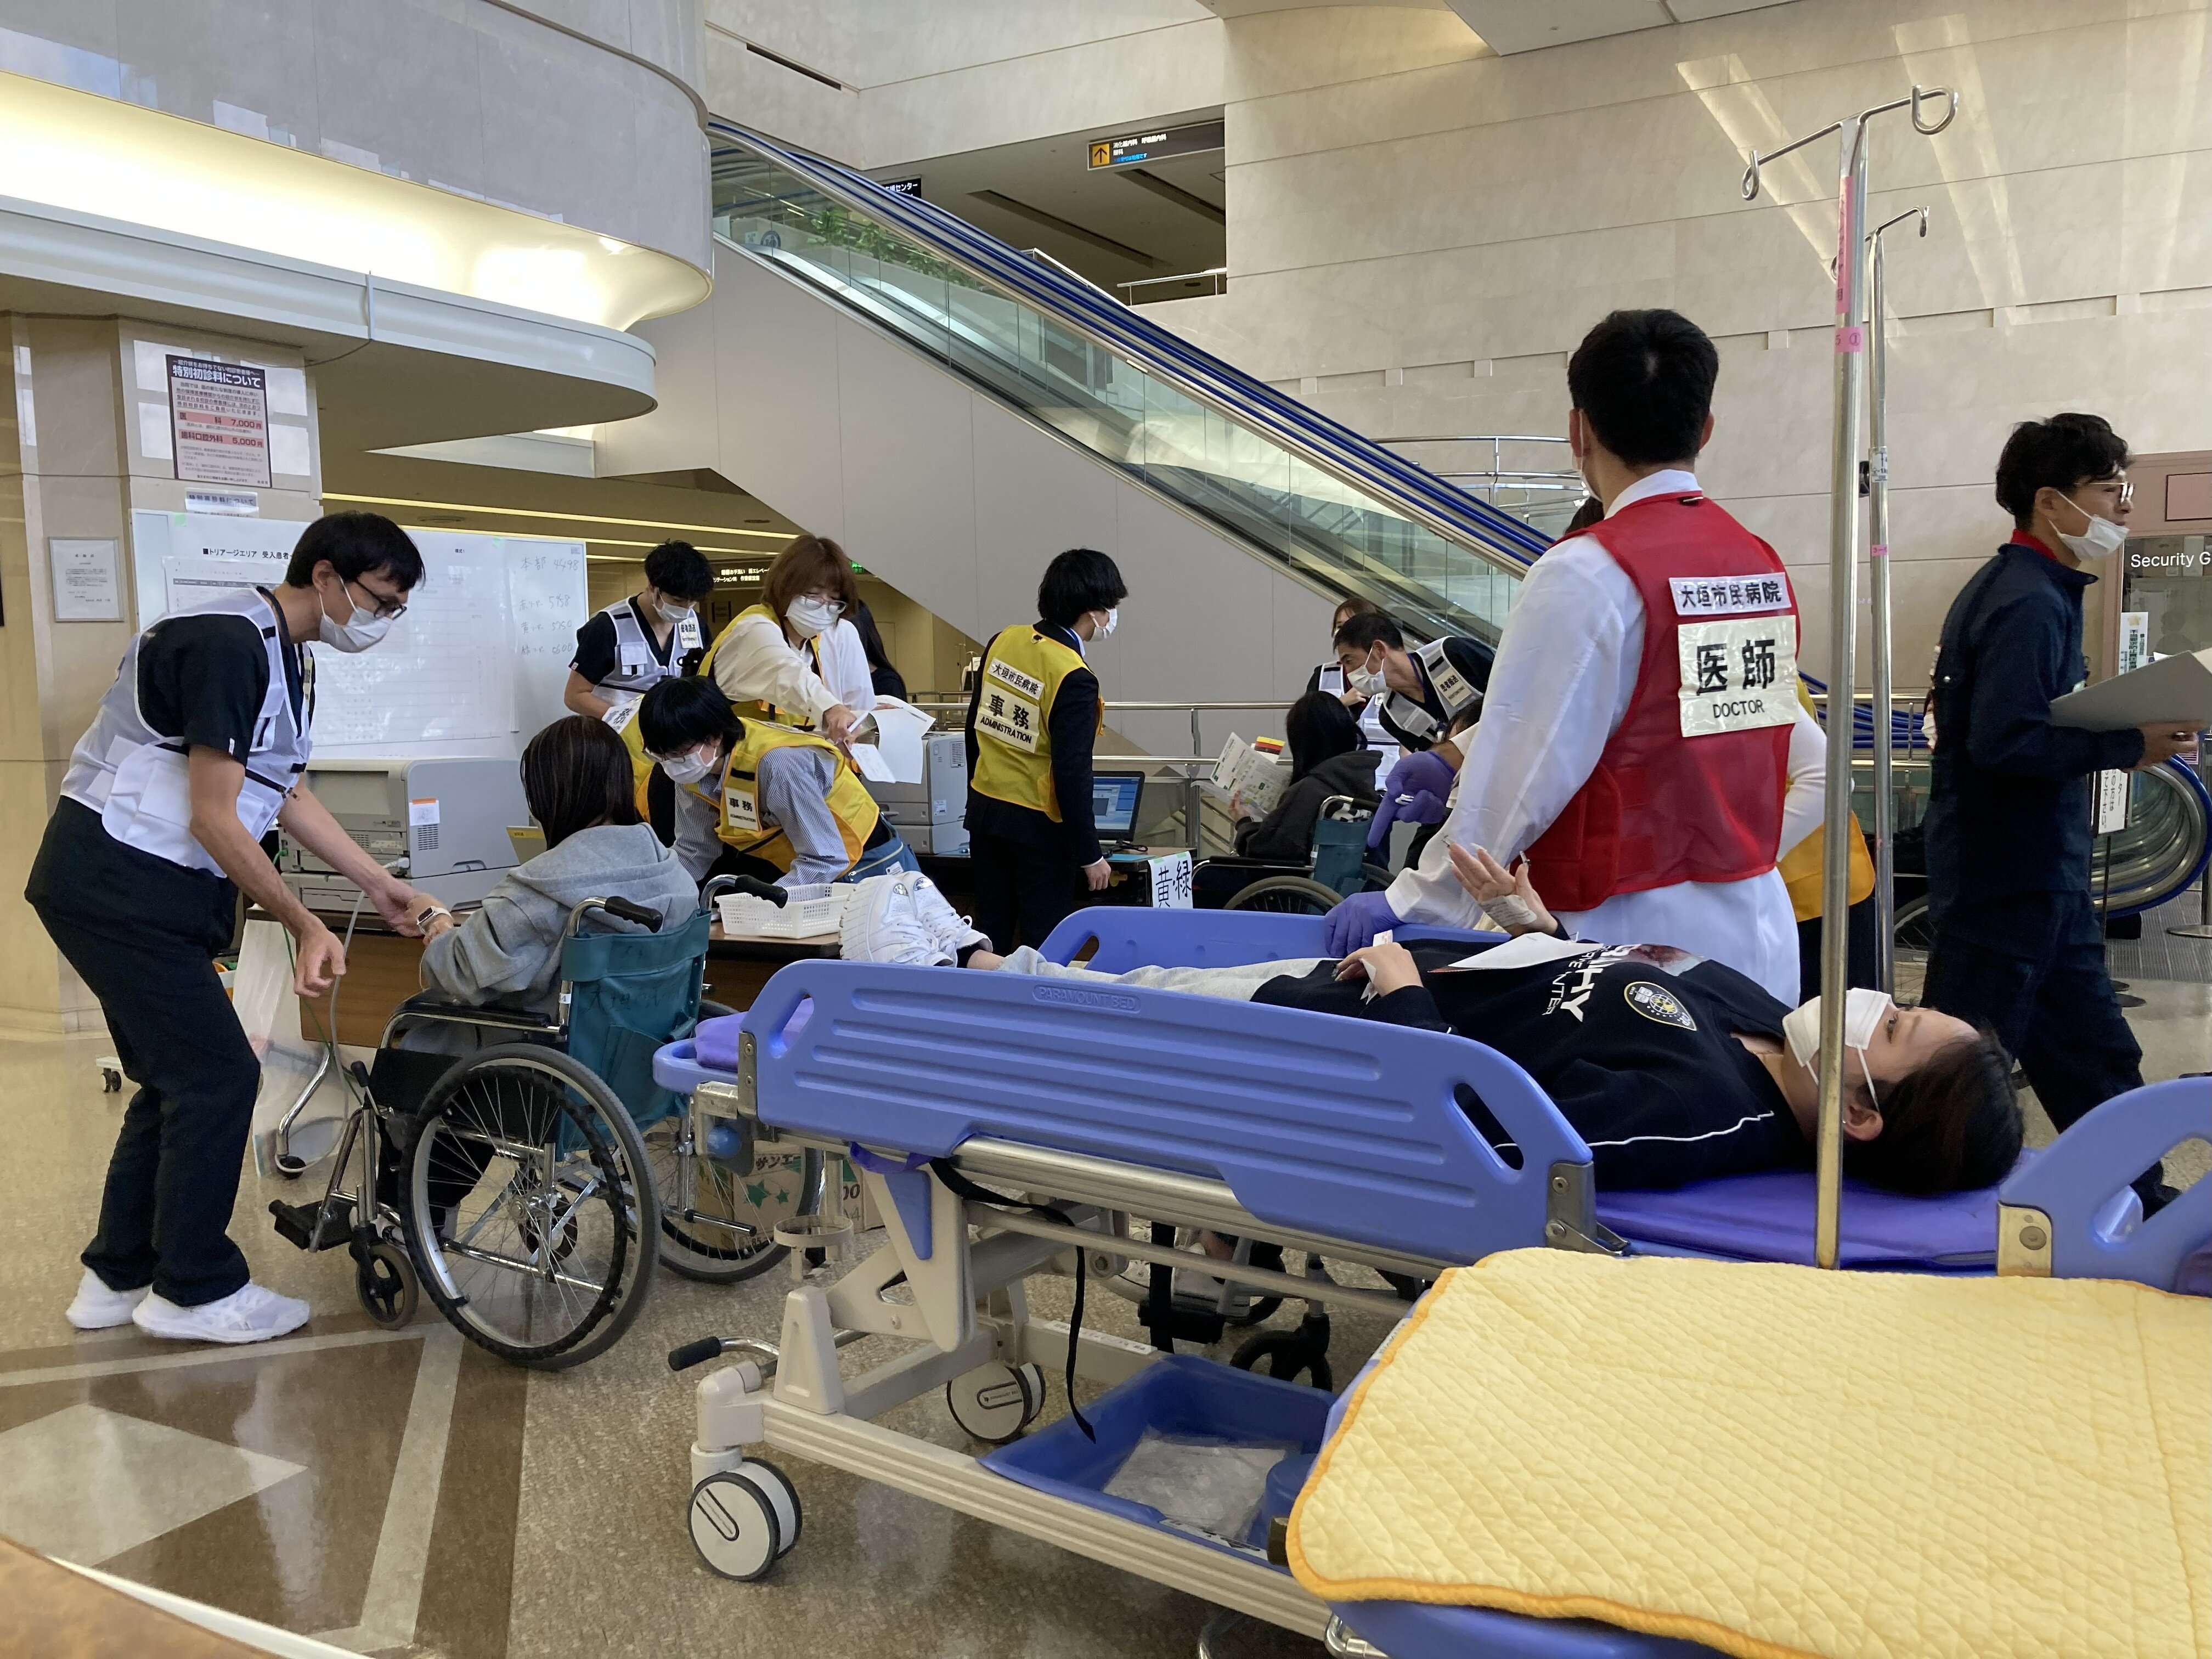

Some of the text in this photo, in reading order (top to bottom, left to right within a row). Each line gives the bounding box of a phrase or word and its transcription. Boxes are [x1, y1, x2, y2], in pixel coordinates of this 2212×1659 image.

[172, 365, 261, 388] 特別初診料について
[181, 431, 223, 443] 歯科口腔外科
[262, 551, 292, 560] 受入患者
[2130, 552, 2194, 568] Security
[1680, 580, 1782, 609] 大垣市民病院
[1696, 639, 1775, 696] 医師
[992, 664, 1039, 695] 大垣市民病院
[988, 693, 1029, 730] 事務
[1713, 699, 1765, 719] DOCTOR
[980, 716, 1032, 744] ADMINISTRATION
[1039, 987, 1136, 1010] PARAMOUNT BED
